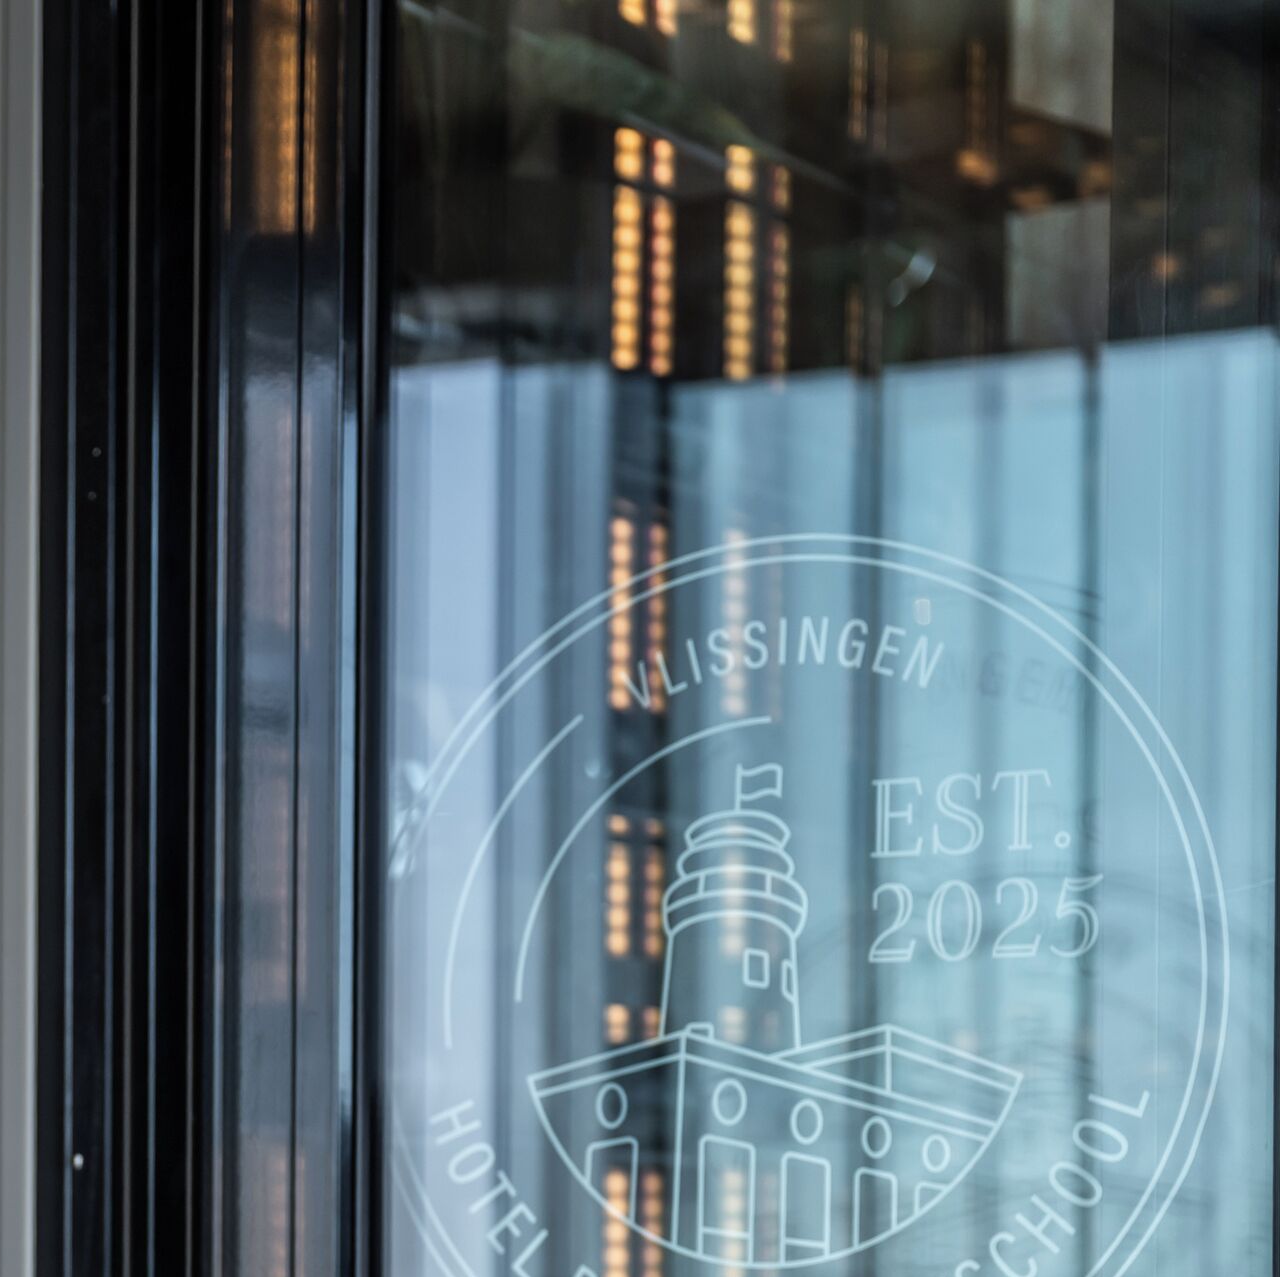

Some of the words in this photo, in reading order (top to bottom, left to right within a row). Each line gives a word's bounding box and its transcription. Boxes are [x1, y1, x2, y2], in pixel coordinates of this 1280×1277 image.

[620, 617, 944, 710] VLISSINGEN
[871, 769, 1072, 859] EST.
[869, 874, 1104, 963] 2025
